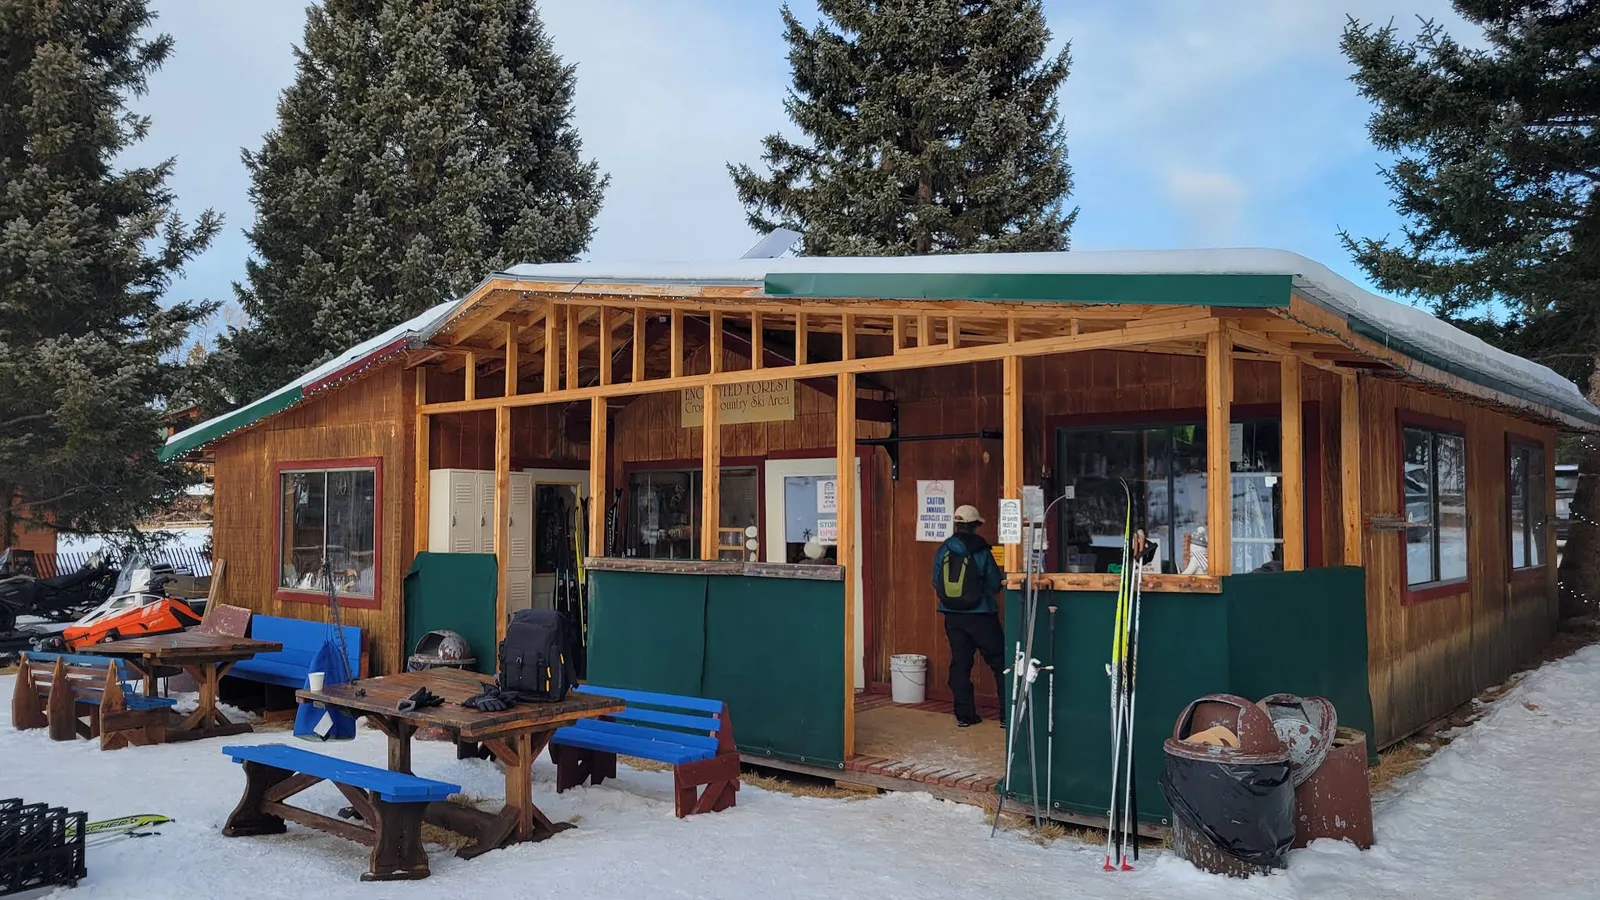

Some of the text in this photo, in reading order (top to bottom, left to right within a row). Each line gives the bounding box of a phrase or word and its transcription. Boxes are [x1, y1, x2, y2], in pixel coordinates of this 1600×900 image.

[684, 379, 789, 401] ENCTED FOREST
[684, 395, 790, 413] Cros ountry Ski Area
[926, 496, 945, 505] CAUTION
[819, 529, 837, 537] OPE
